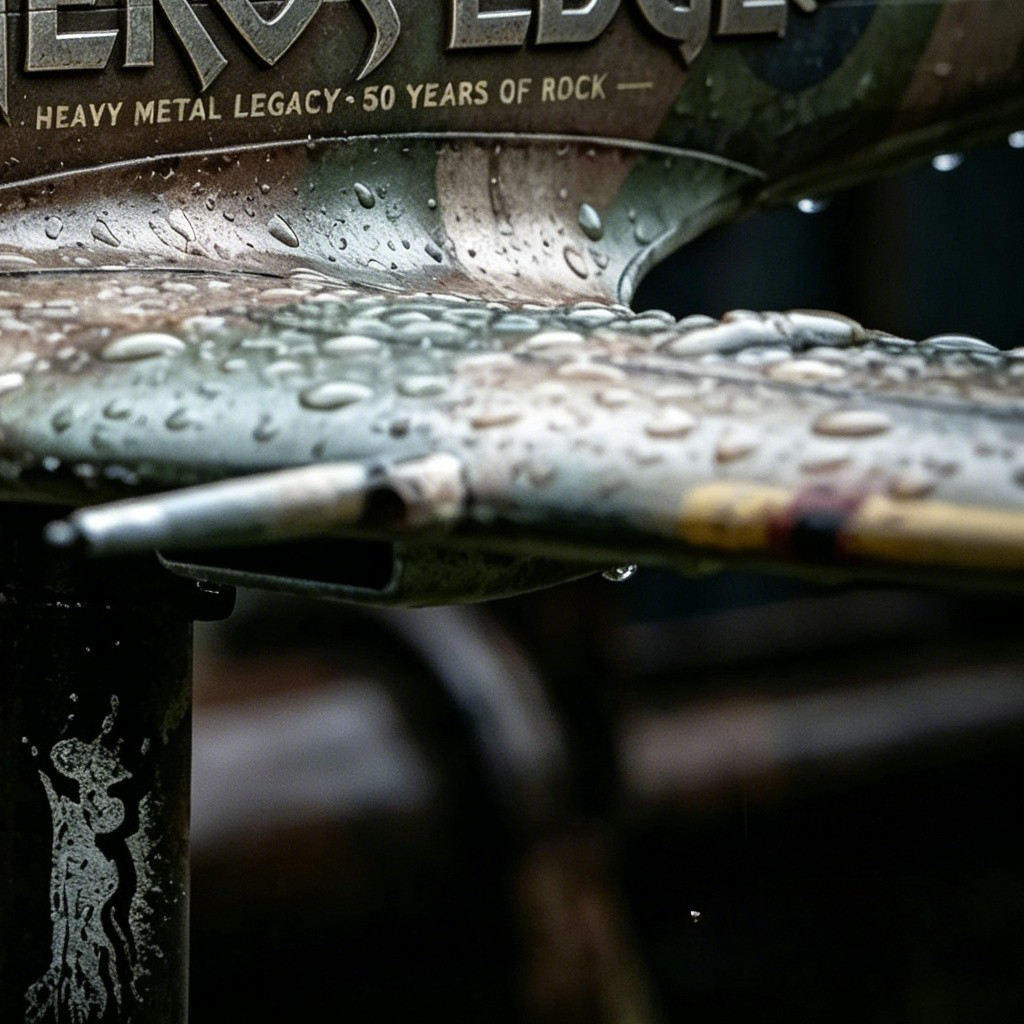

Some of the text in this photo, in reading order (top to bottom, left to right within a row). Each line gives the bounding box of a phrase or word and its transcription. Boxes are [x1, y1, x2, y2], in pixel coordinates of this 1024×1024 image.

[36, 72, 609, 130] HEAVY METAL LEGACY 50 YEARS OF ROCK
